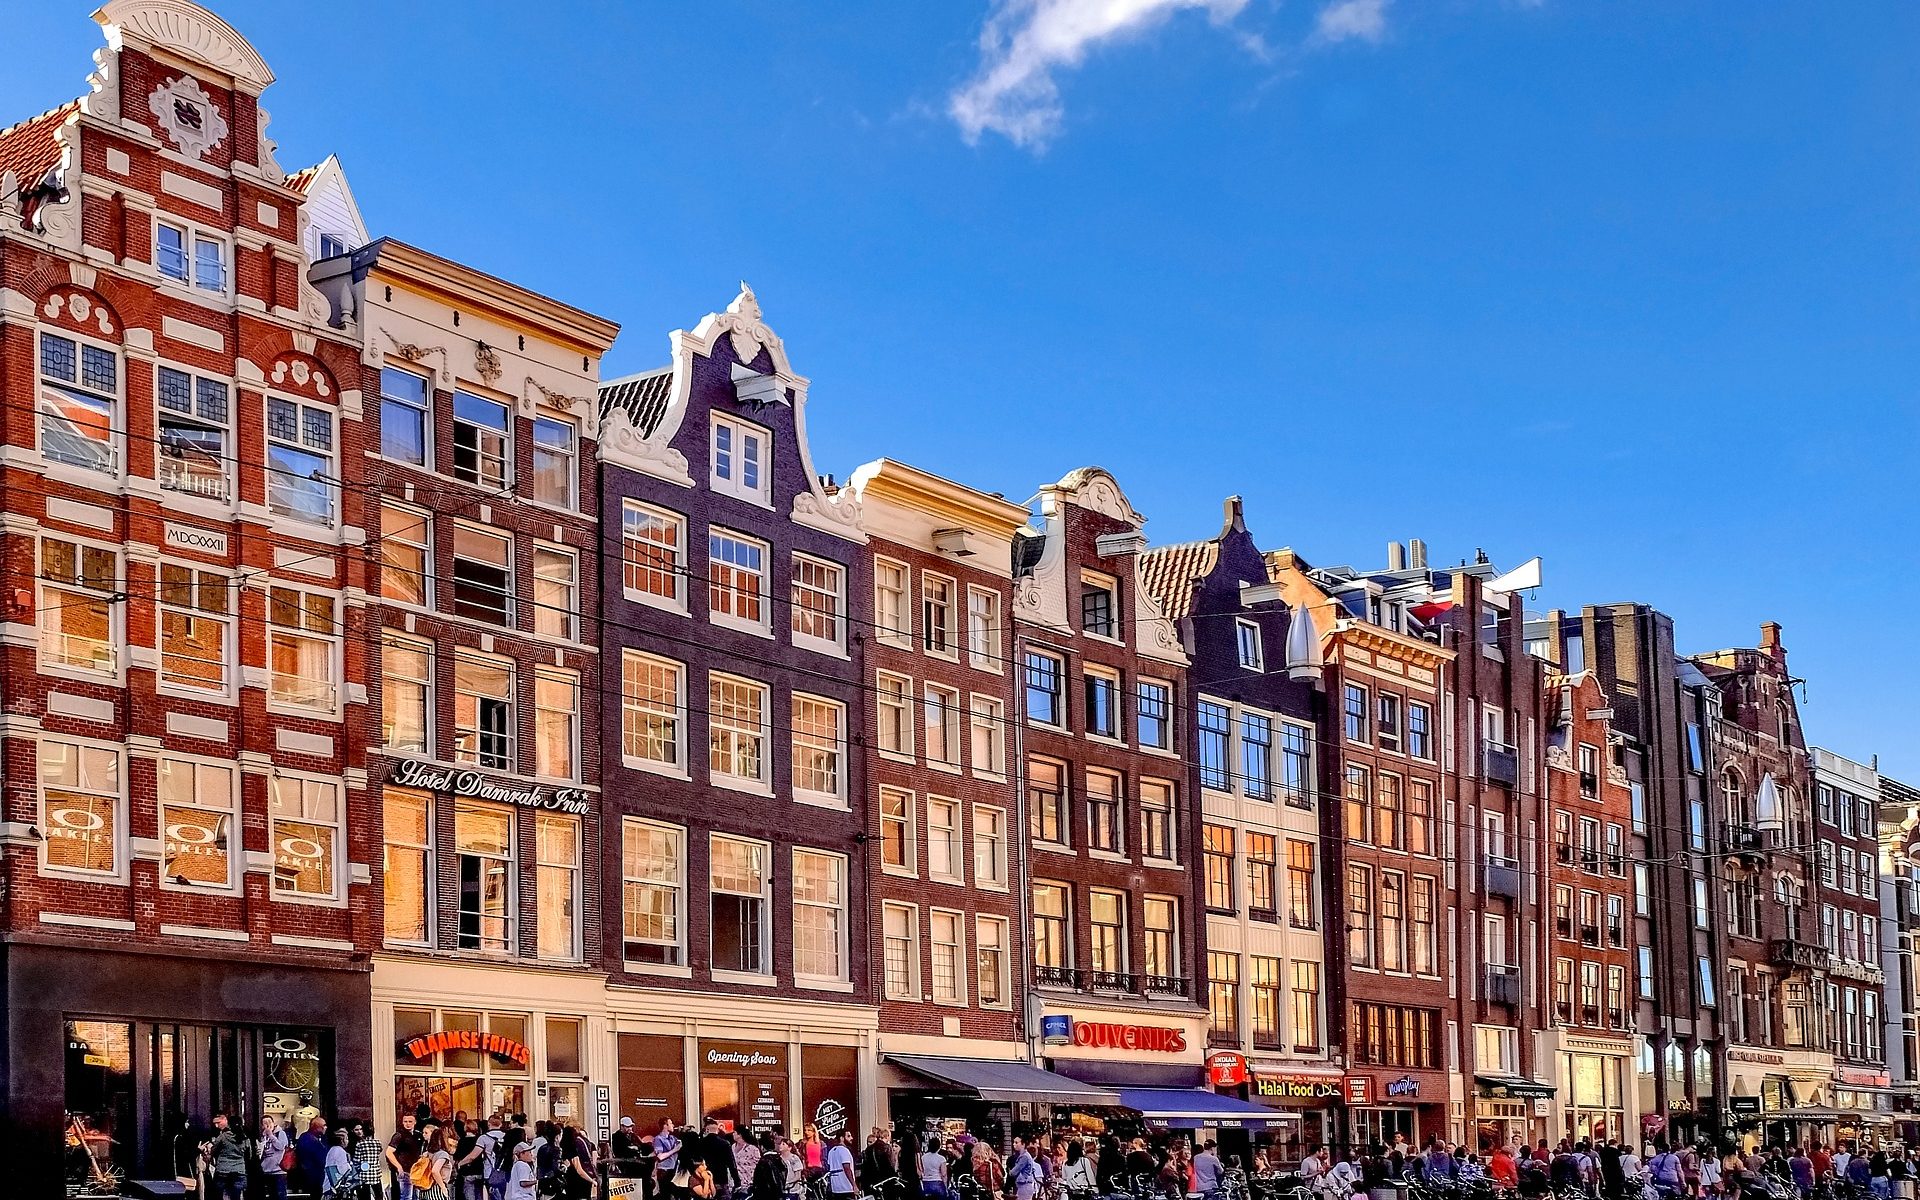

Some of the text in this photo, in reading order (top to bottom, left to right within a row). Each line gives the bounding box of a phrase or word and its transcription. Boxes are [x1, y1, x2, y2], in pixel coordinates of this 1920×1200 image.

[167, 529, 224, 552] MDCXXXII
[394, 759, 590, 815] Hotel Damrak Inn
[1073, 1020, 1187, 1052] OUVENIRS
[266, 1052, 314, 1060] OAKLEY
[408, 1031, 531, 1065] VLAAMSE FRITES
[708, 1049, 777, 1067] Opening Soon
[1258, 1080, 1314, 1097] Halal Food
[1316, 1083, 1342, 1098] حلال
[597, 1087, 610, 1140] HOTE
